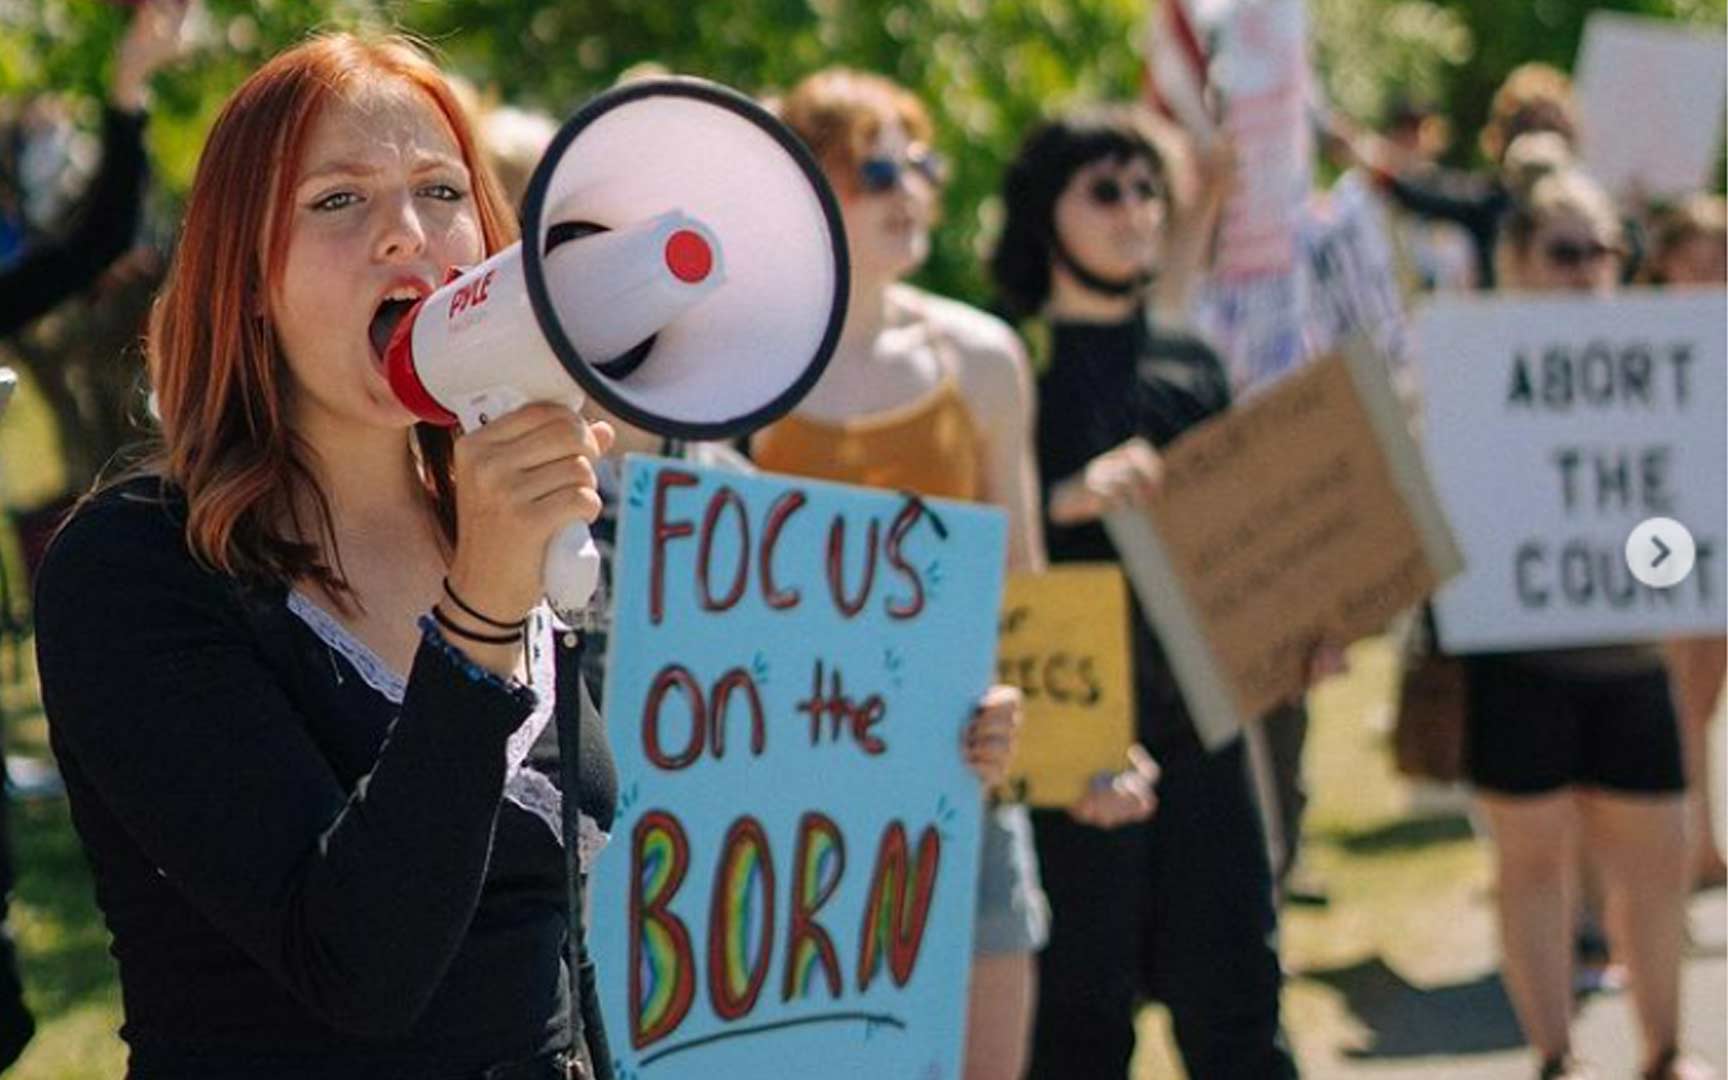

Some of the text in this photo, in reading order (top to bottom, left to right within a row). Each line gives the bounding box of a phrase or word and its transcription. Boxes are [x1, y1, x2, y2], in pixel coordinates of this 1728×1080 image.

[449, 269, 496, 319] PYLE
[1507, 342, 1695, 410] ABORT
[1553, 448, 1675, 513] THE
[650, 469, 947, 626] FOCUS
[1515, 536, 1714, 609] COUT
[797, 657, 887, 756] the
[628, 809, 941, 1050] BORN
